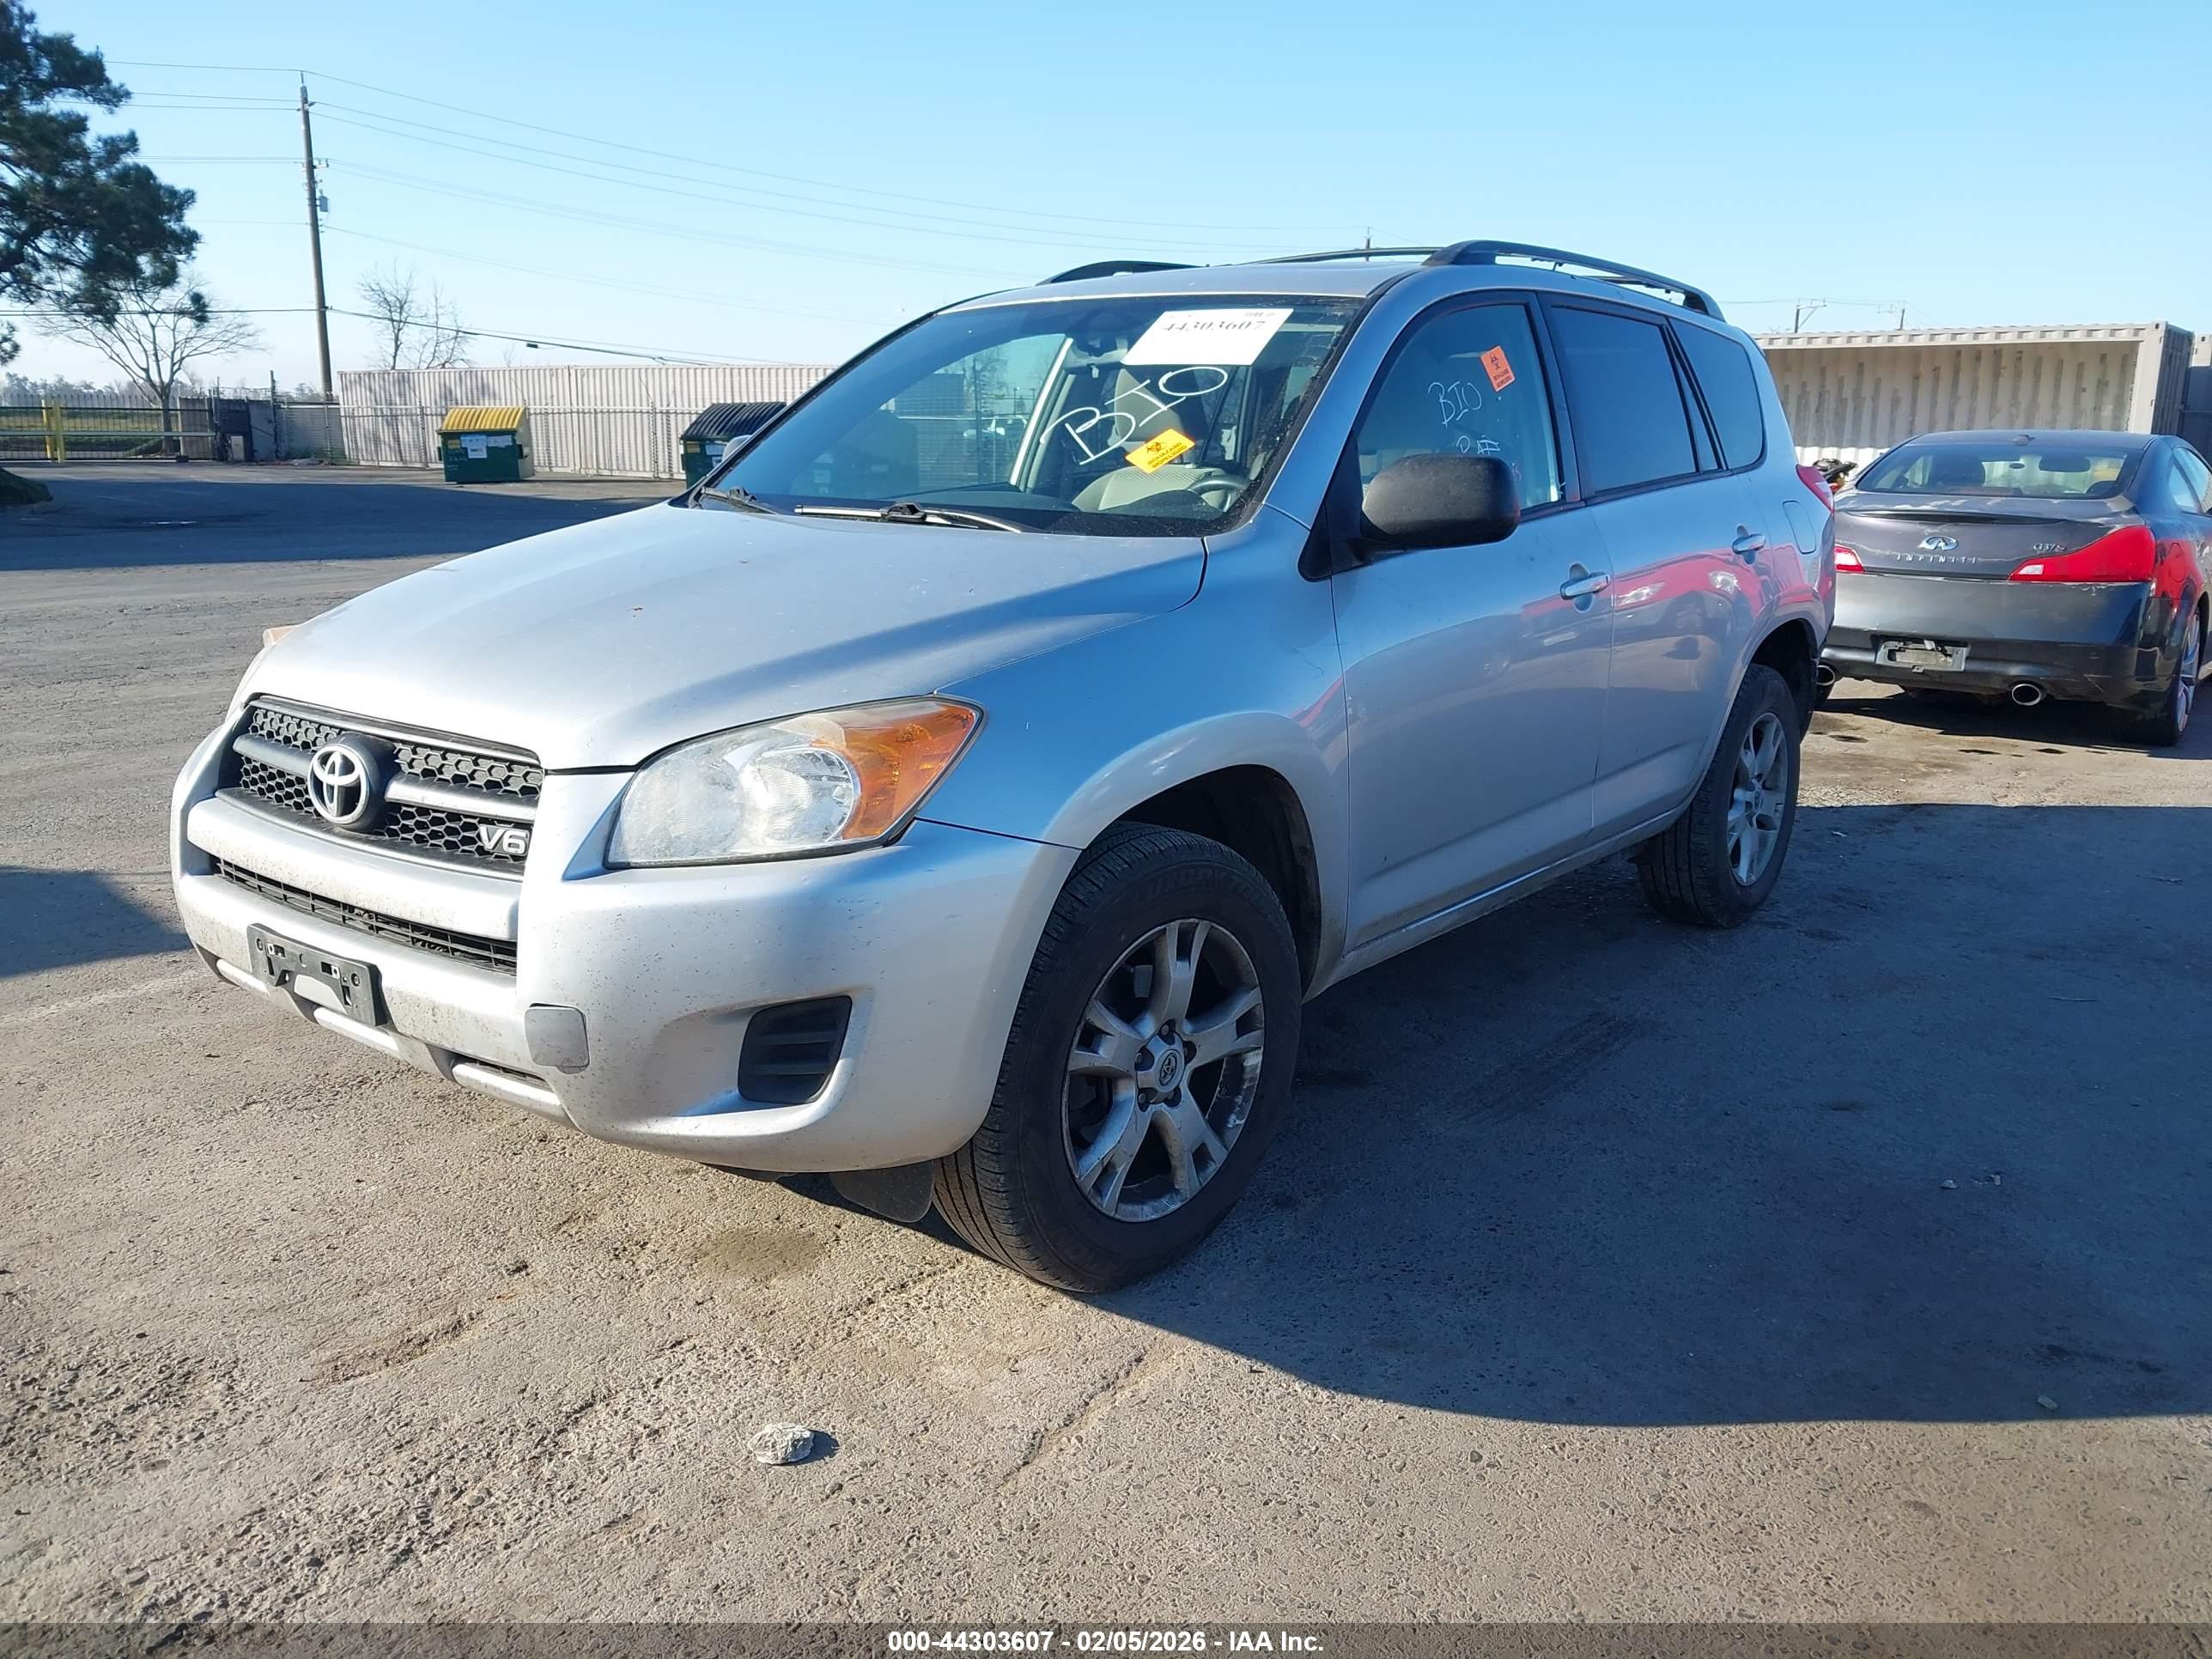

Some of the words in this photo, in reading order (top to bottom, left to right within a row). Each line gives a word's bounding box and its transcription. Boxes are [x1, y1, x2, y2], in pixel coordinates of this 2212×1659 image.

[1039, 366, 1229, 465] BIO
[1427, 380, 1482, 428] BIO
[1896, 552, 1977, 564] INFINITI
[479, 824, 529, 854] V6
